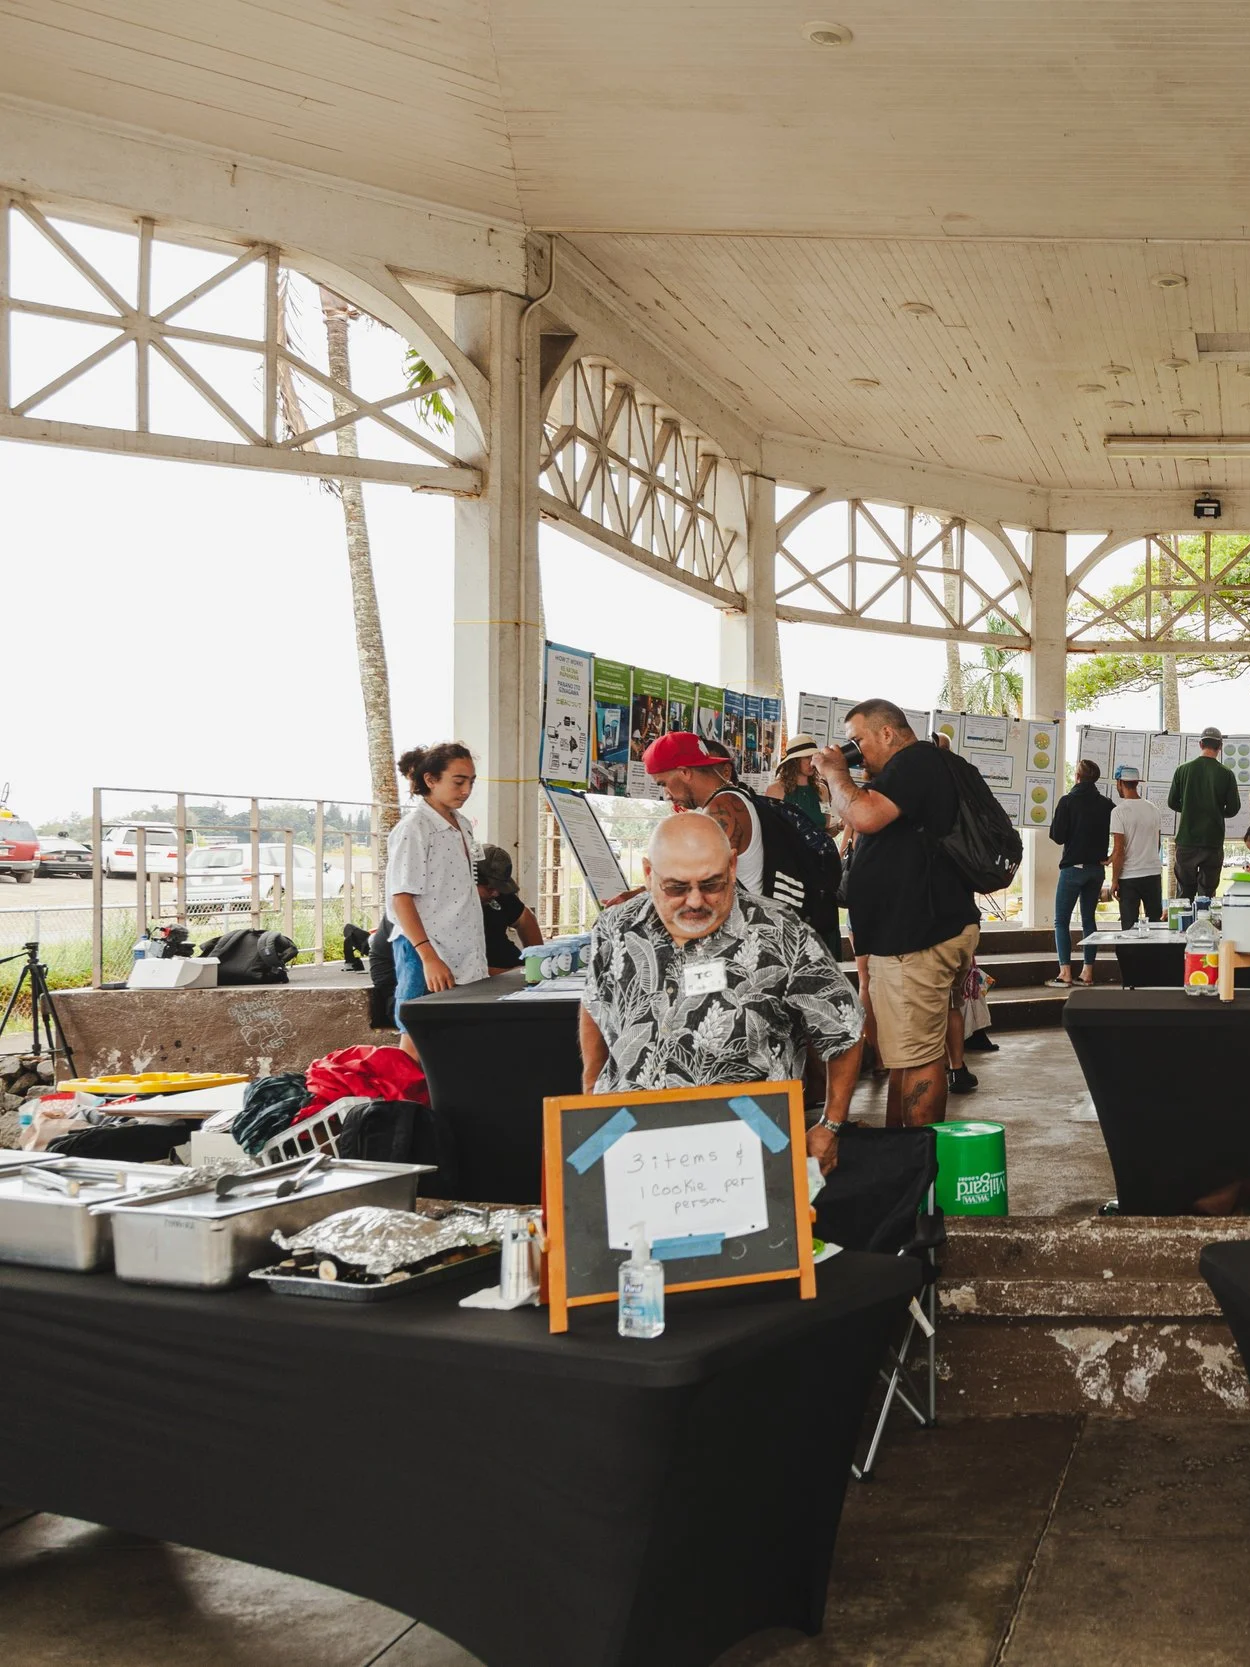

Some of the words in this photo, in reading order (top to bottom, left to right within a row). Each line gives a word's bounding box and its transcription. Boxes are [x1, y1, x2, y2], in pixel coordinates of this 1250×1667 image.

[627, 1153, 645, 1174] 3
[651, 1151, 718, 1169] items
[724, 1177, 755, 1193] per
[955, 1172, 1006, 1202] Milgard
[674, 1196, 727, 1215] person
